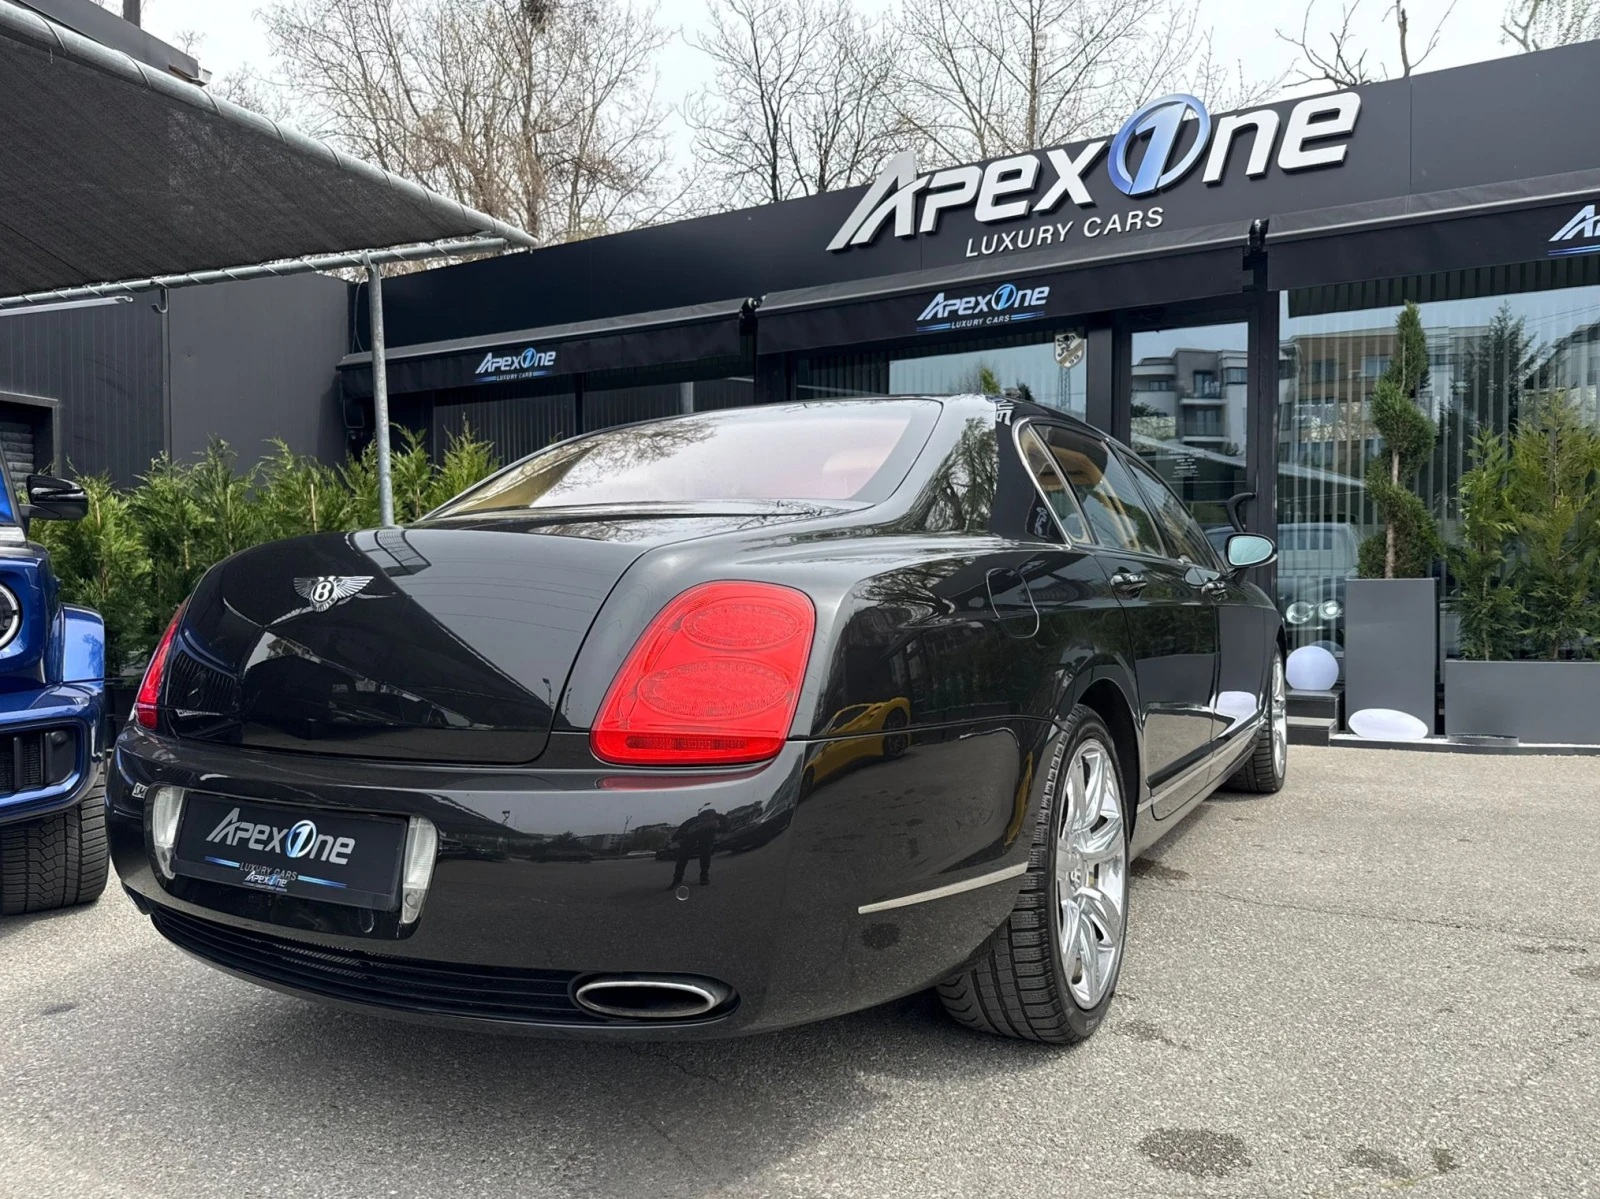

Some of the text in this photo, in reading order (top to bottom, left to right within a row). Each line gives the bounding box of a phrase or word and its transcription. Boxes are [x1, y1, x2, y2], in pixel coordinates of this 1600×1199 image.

[965, 207, 1164, 257] LUXURY CARS
[951, 314, 1010, 329] LUXURY CARS
[496, 371, 533, 381] LUXURY CARS
[240, 862, 298, 881] LUXURY CARS
